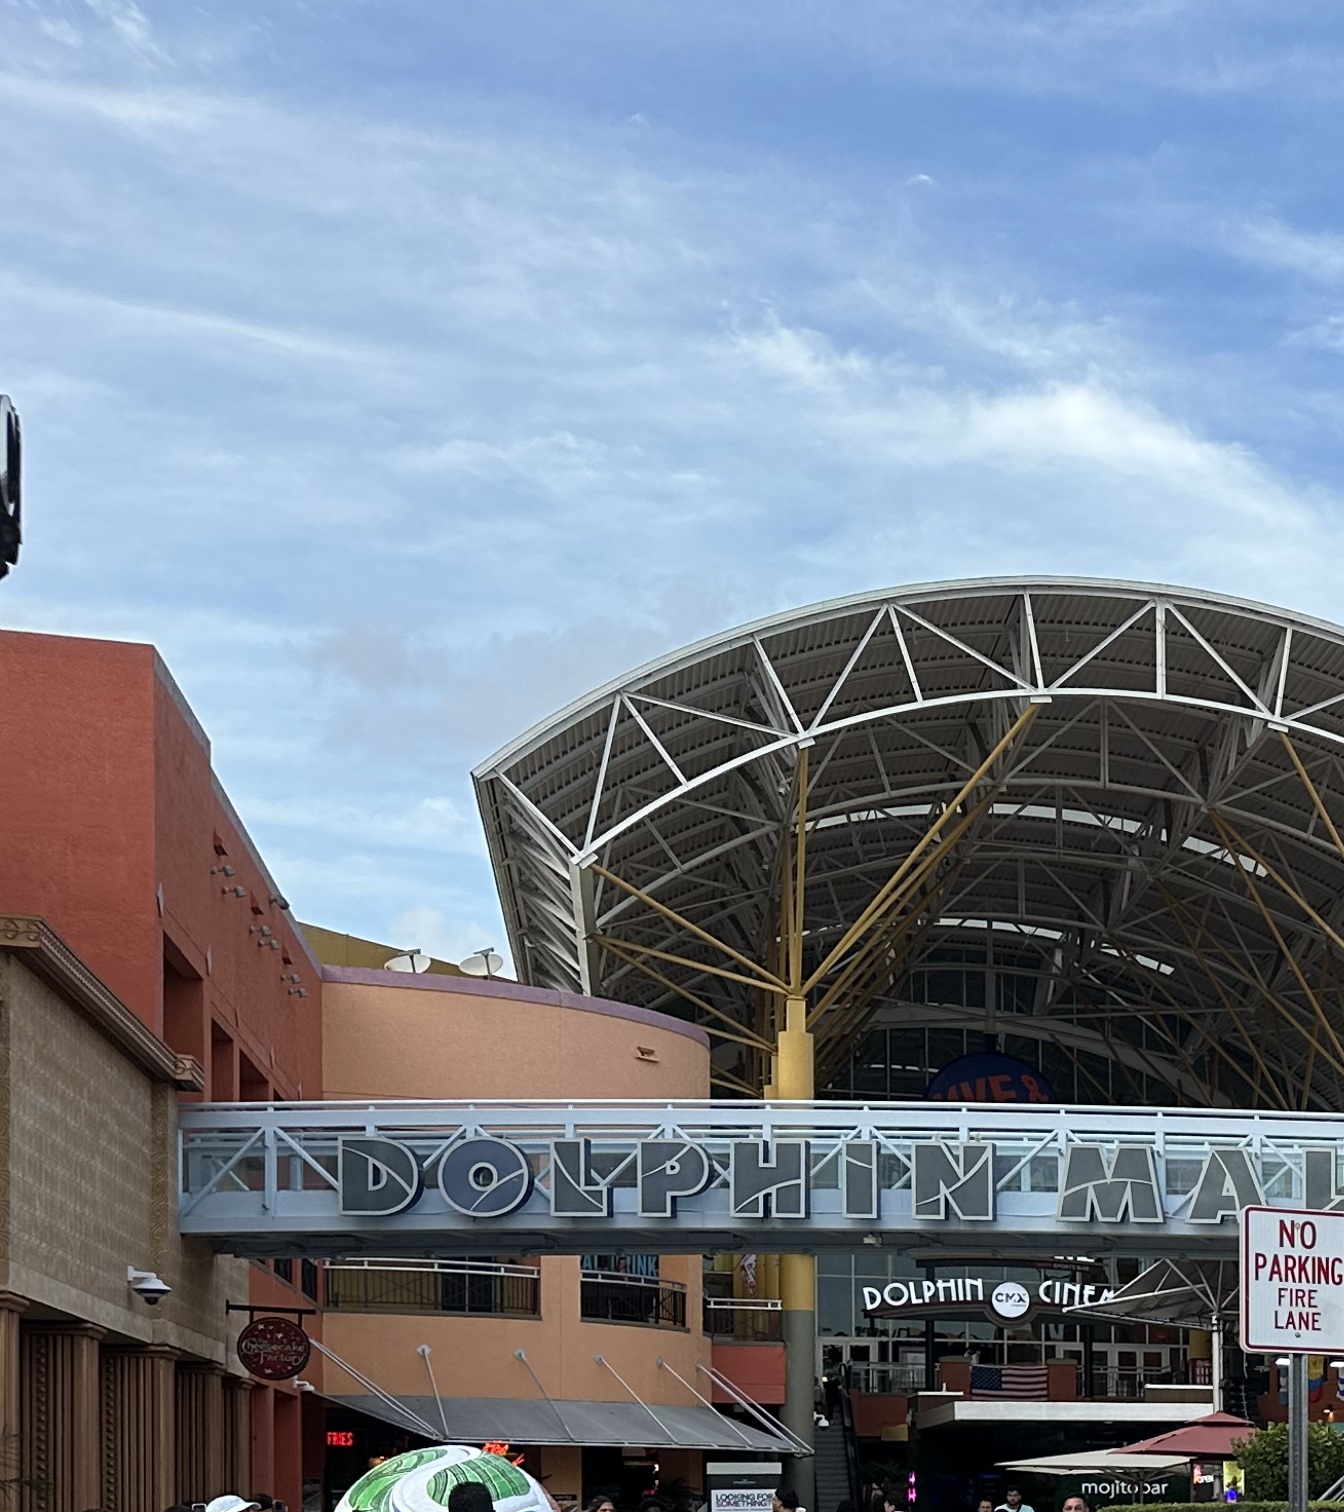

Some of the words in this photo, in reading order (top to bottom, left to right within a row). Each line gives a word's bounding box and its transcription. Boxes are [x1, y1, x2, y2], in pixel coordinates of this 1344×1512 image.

[338, 1137, 997, 1220] DOLPHIN
[1279, 1219, 1317, 1249] NO
[1254, 1252, 1344, 1286] PARKING
[863, 1278, 984, 1311] DOLPHIN
[994, 1292, 1027, 1303] CMX
[1278, 1288, 1318, 1308] FIRE
[1274, 1310, 1322, 1331] LANE
[260, 1350, 305, 1366] Factory
[1081, 1480, 1138, 1498] mojito
